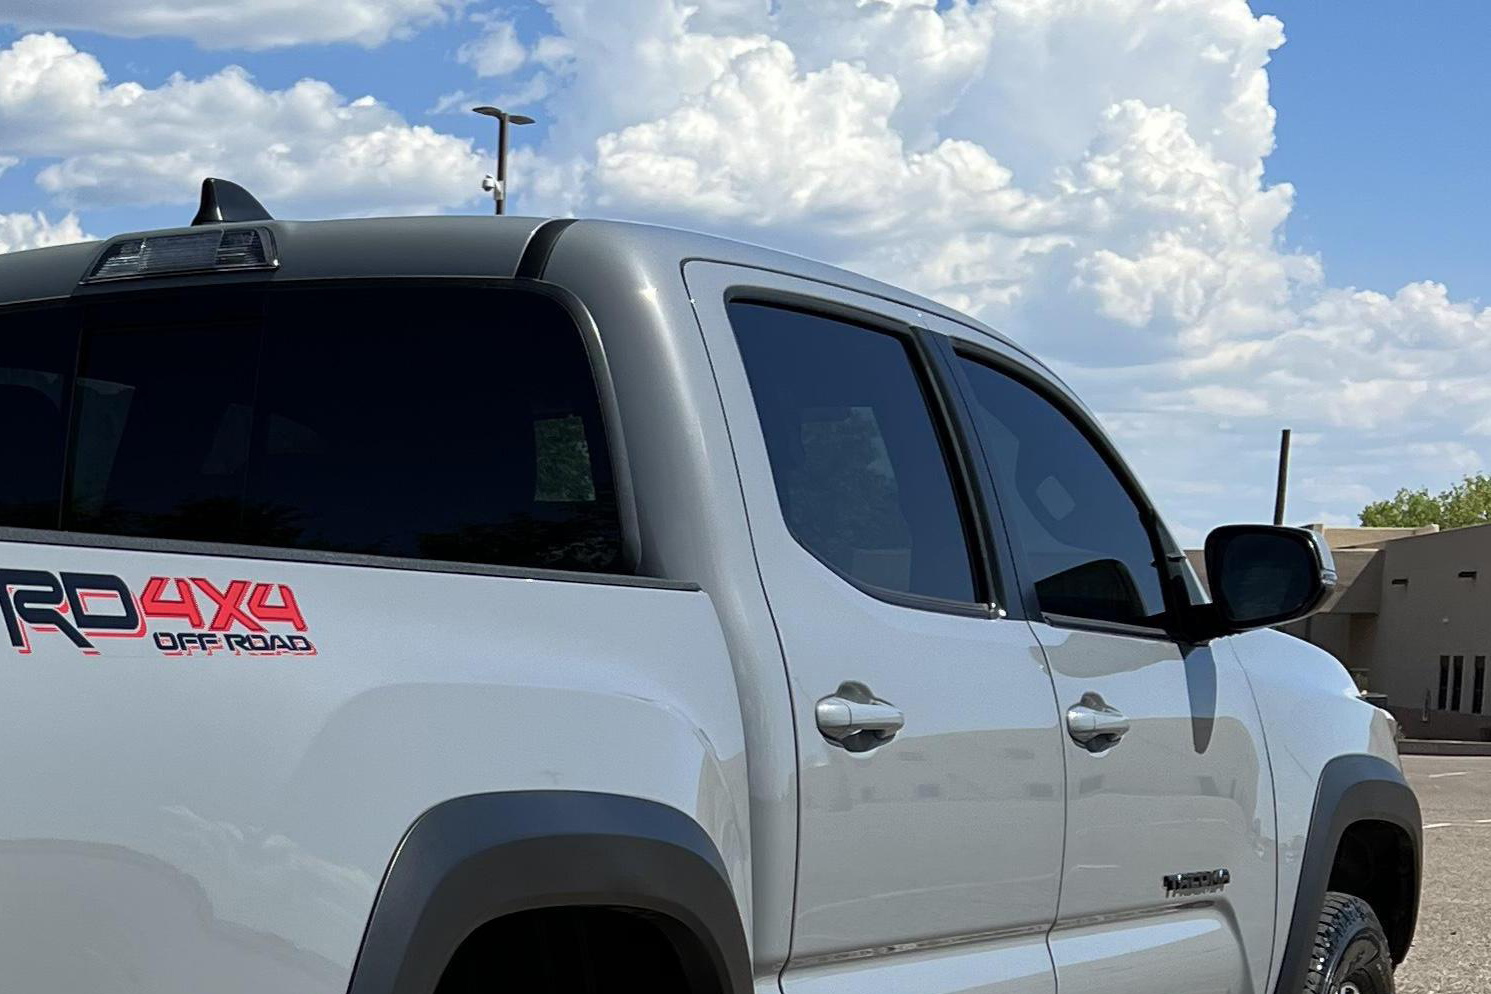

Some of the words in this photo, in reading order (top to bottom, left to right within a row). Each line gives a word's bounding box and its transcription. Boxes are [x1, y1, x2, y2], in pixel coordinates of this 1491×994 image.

[140, 575, 309, 634] 4X4
[153, 631, 220, 655] OFF
[226, 632, 316, 655] ROAD
